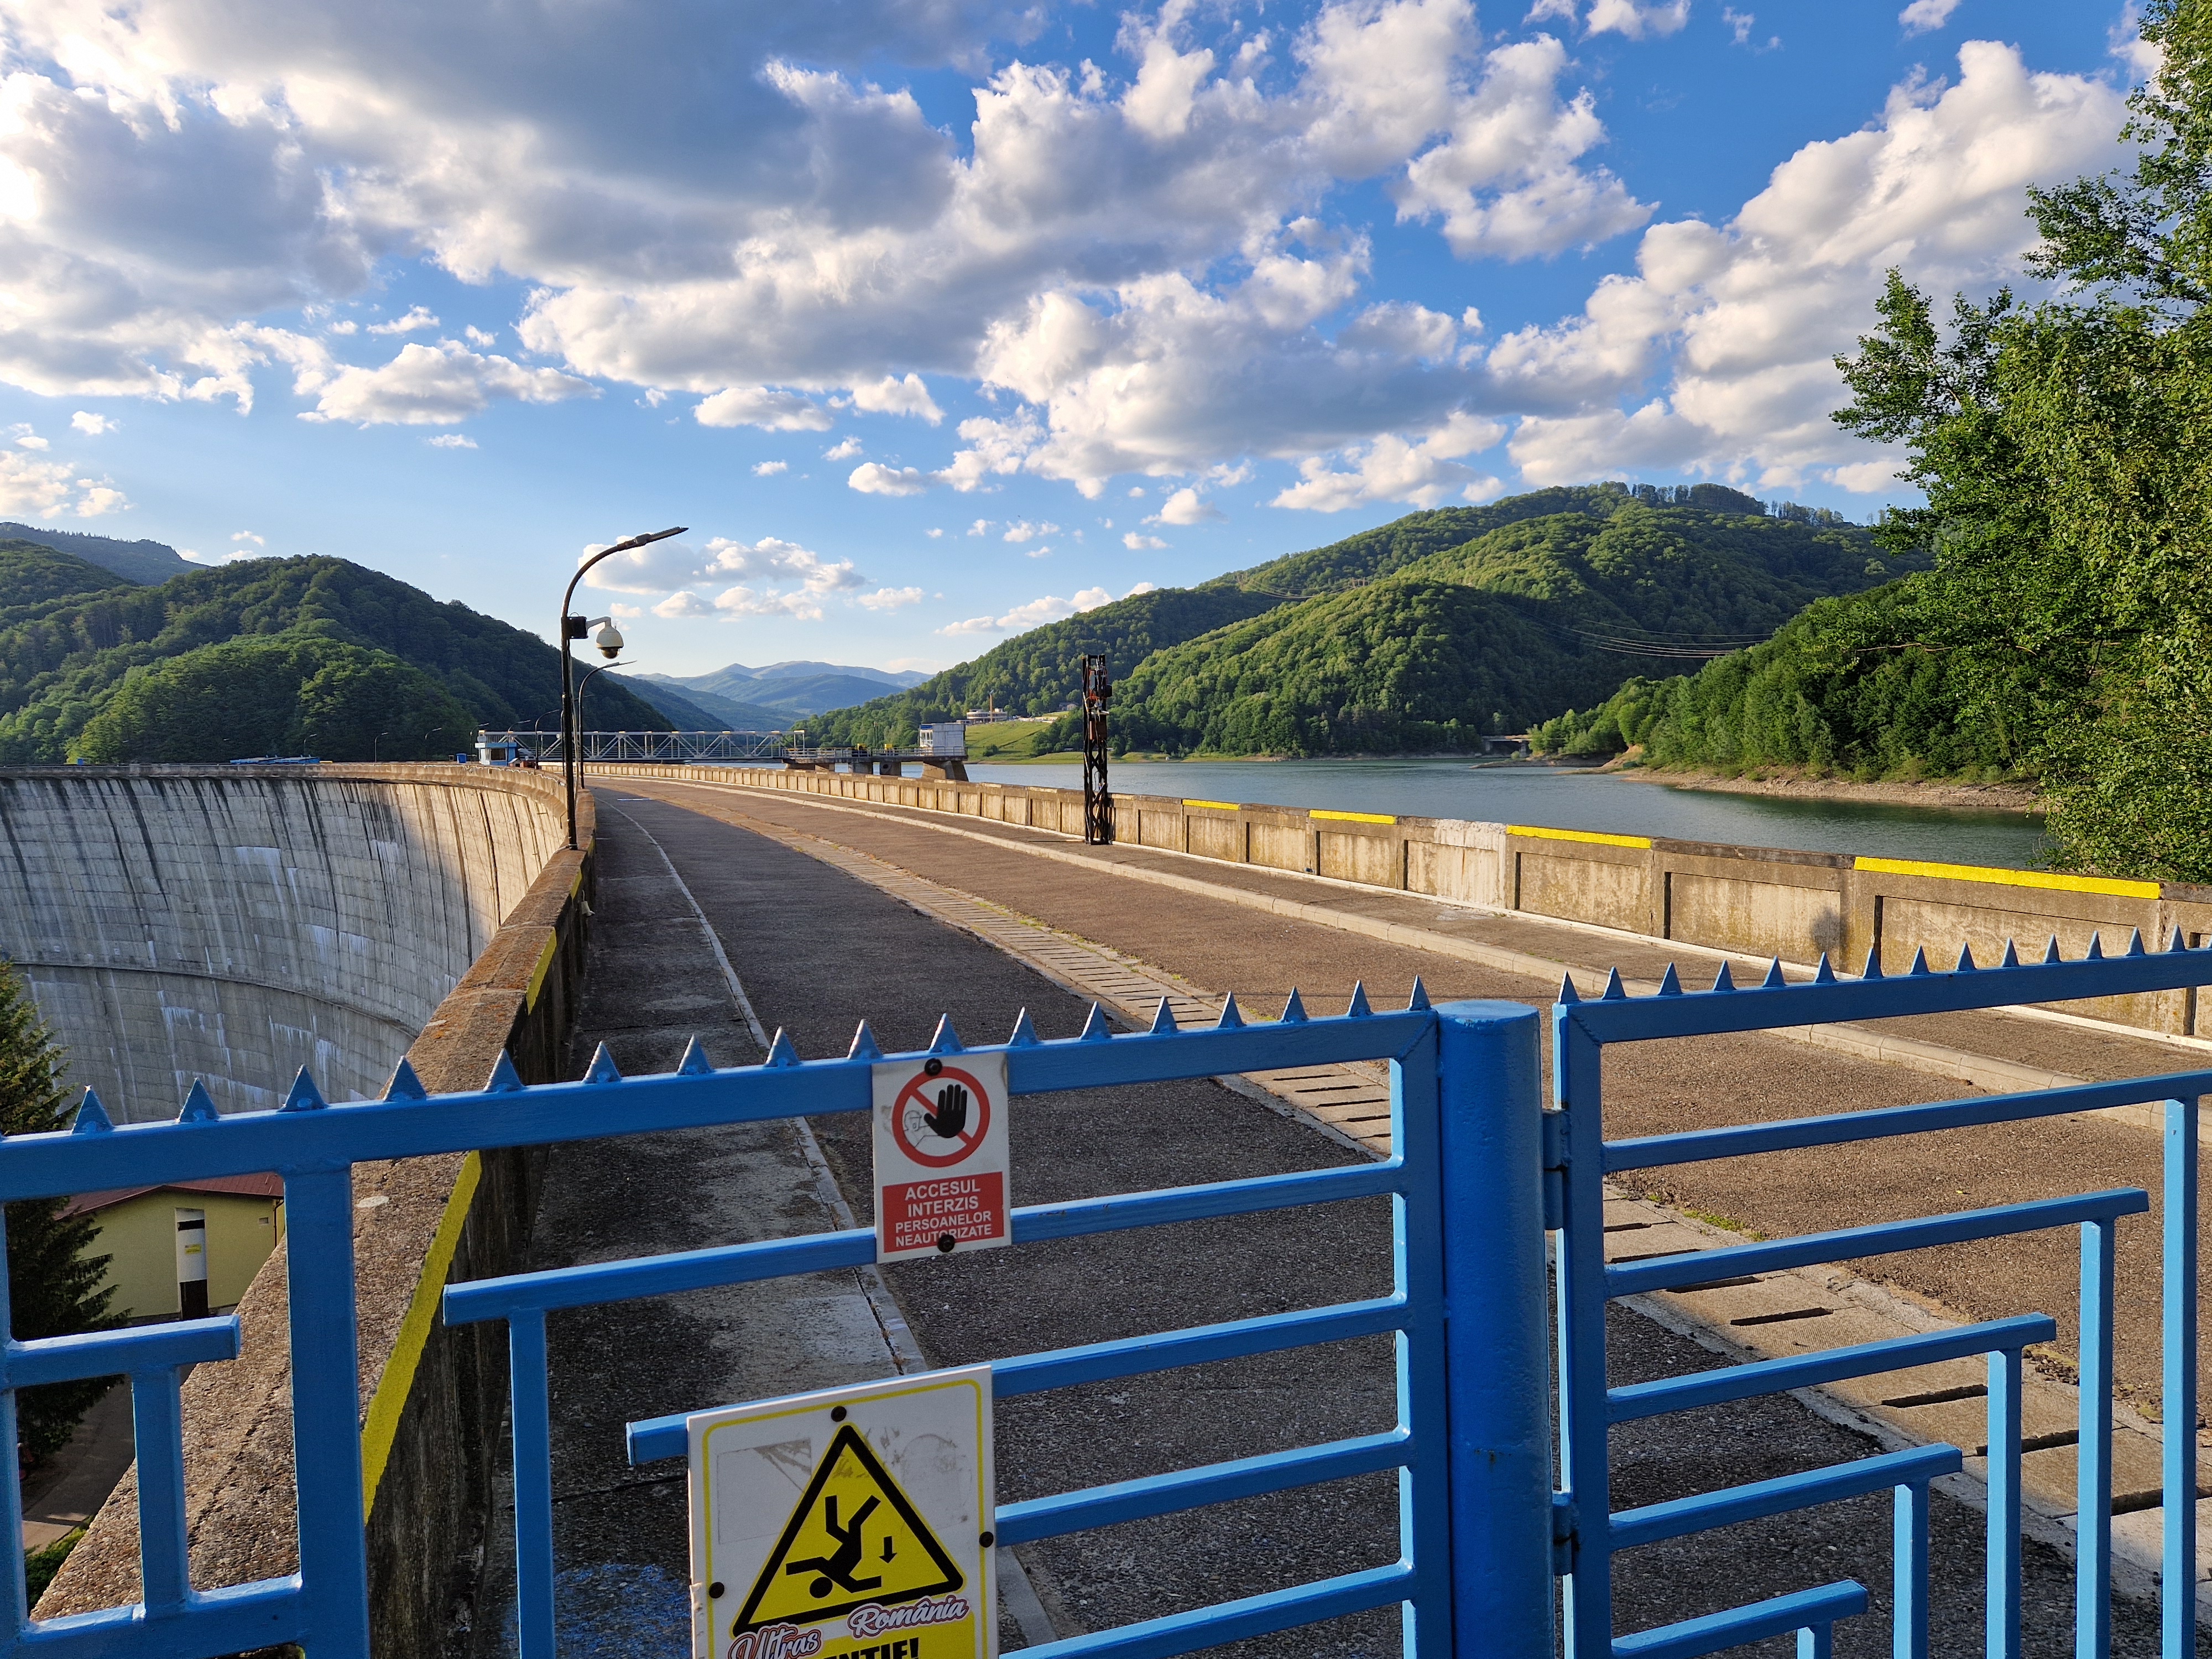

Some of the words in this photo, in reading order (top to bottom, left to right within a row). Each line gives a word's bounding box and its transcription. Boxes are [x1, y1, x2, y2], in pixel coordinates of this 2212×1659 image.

[905, 1178, 981, 1201] ACCESUL
[907, 1196, 979, 1217] INTERZIS
[895, 1211, 992, 1233] PERSOANELOR
[728, 1625, 820, 1659] Ultras
[848, 1595, 969, 1637] România
